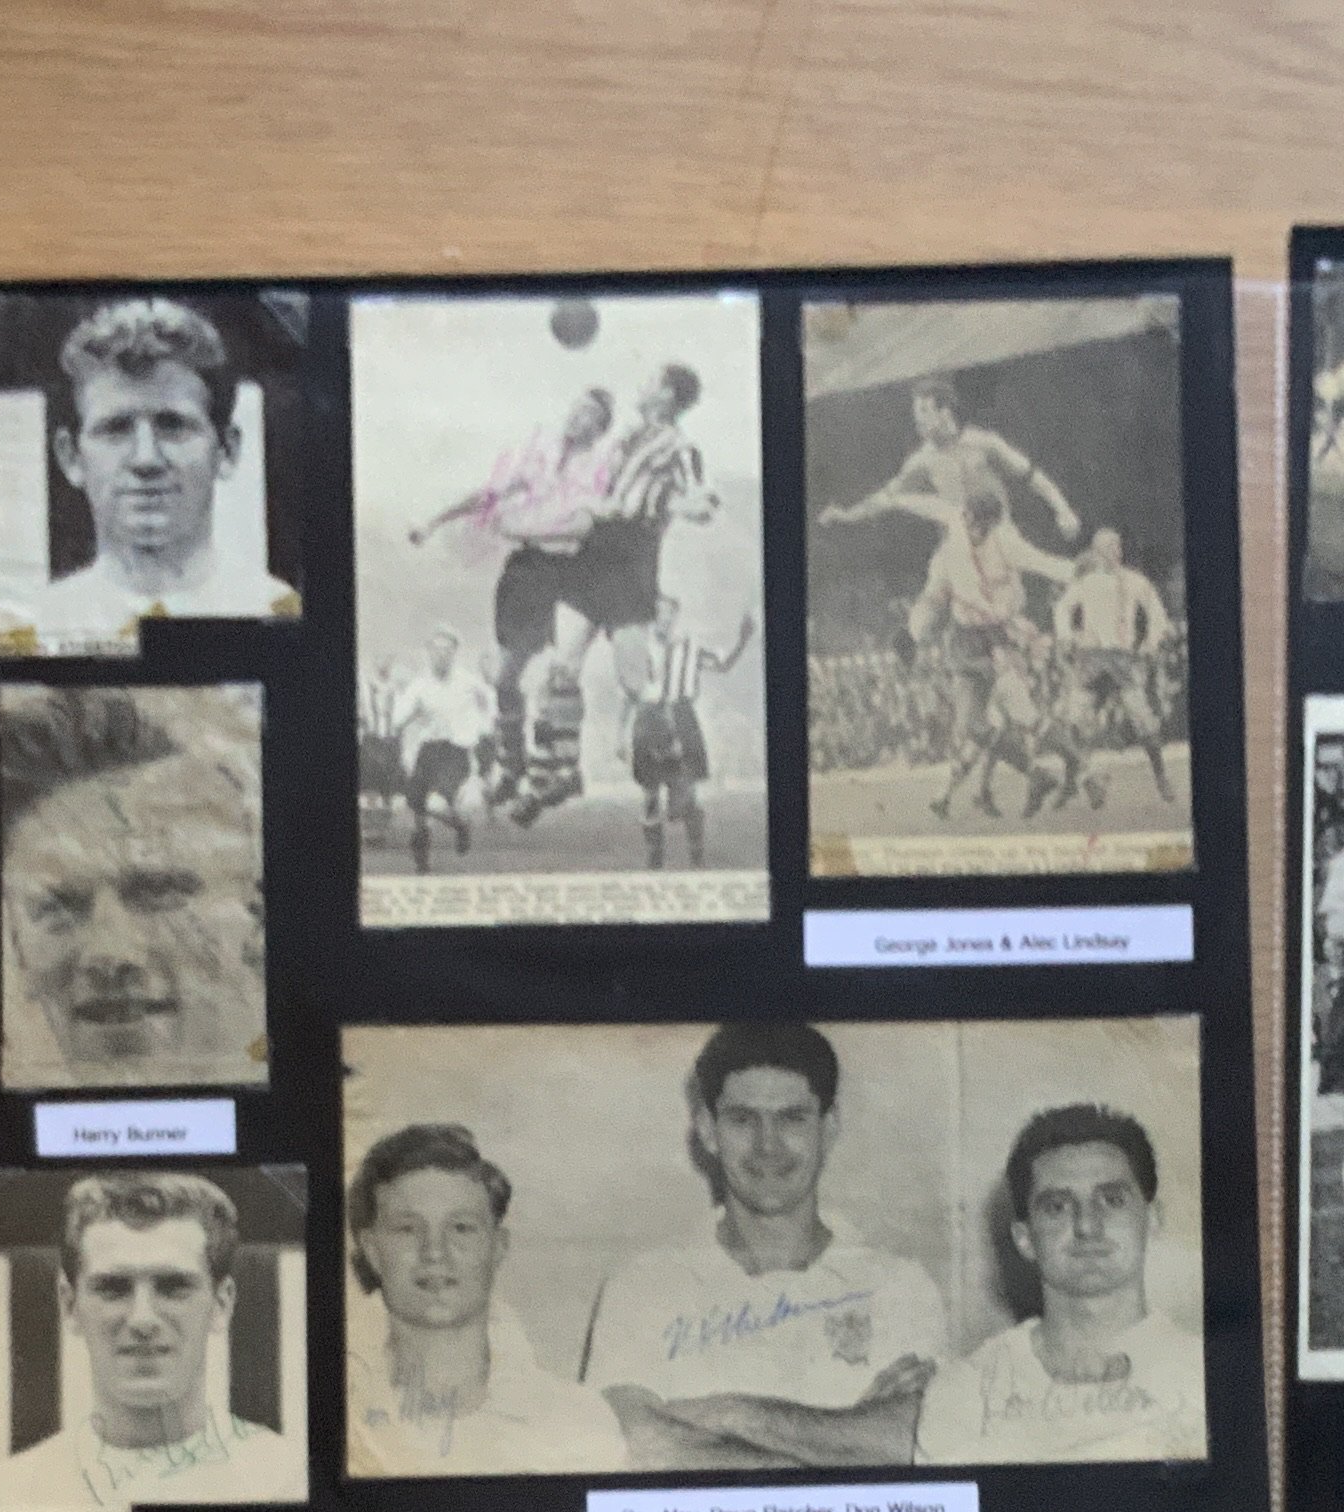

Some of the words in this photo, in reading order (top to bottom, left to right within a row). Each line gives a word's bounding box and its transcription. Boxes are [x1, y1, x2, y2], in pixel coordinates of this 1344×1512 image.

[874, 935, 938, 957] George
[943, 935, 995, 953] Jones
[999, 934, 1013, 952] &
[72, 1127, 122, 1146] Harry
[126, 1126, 189, 1143] Bunner
